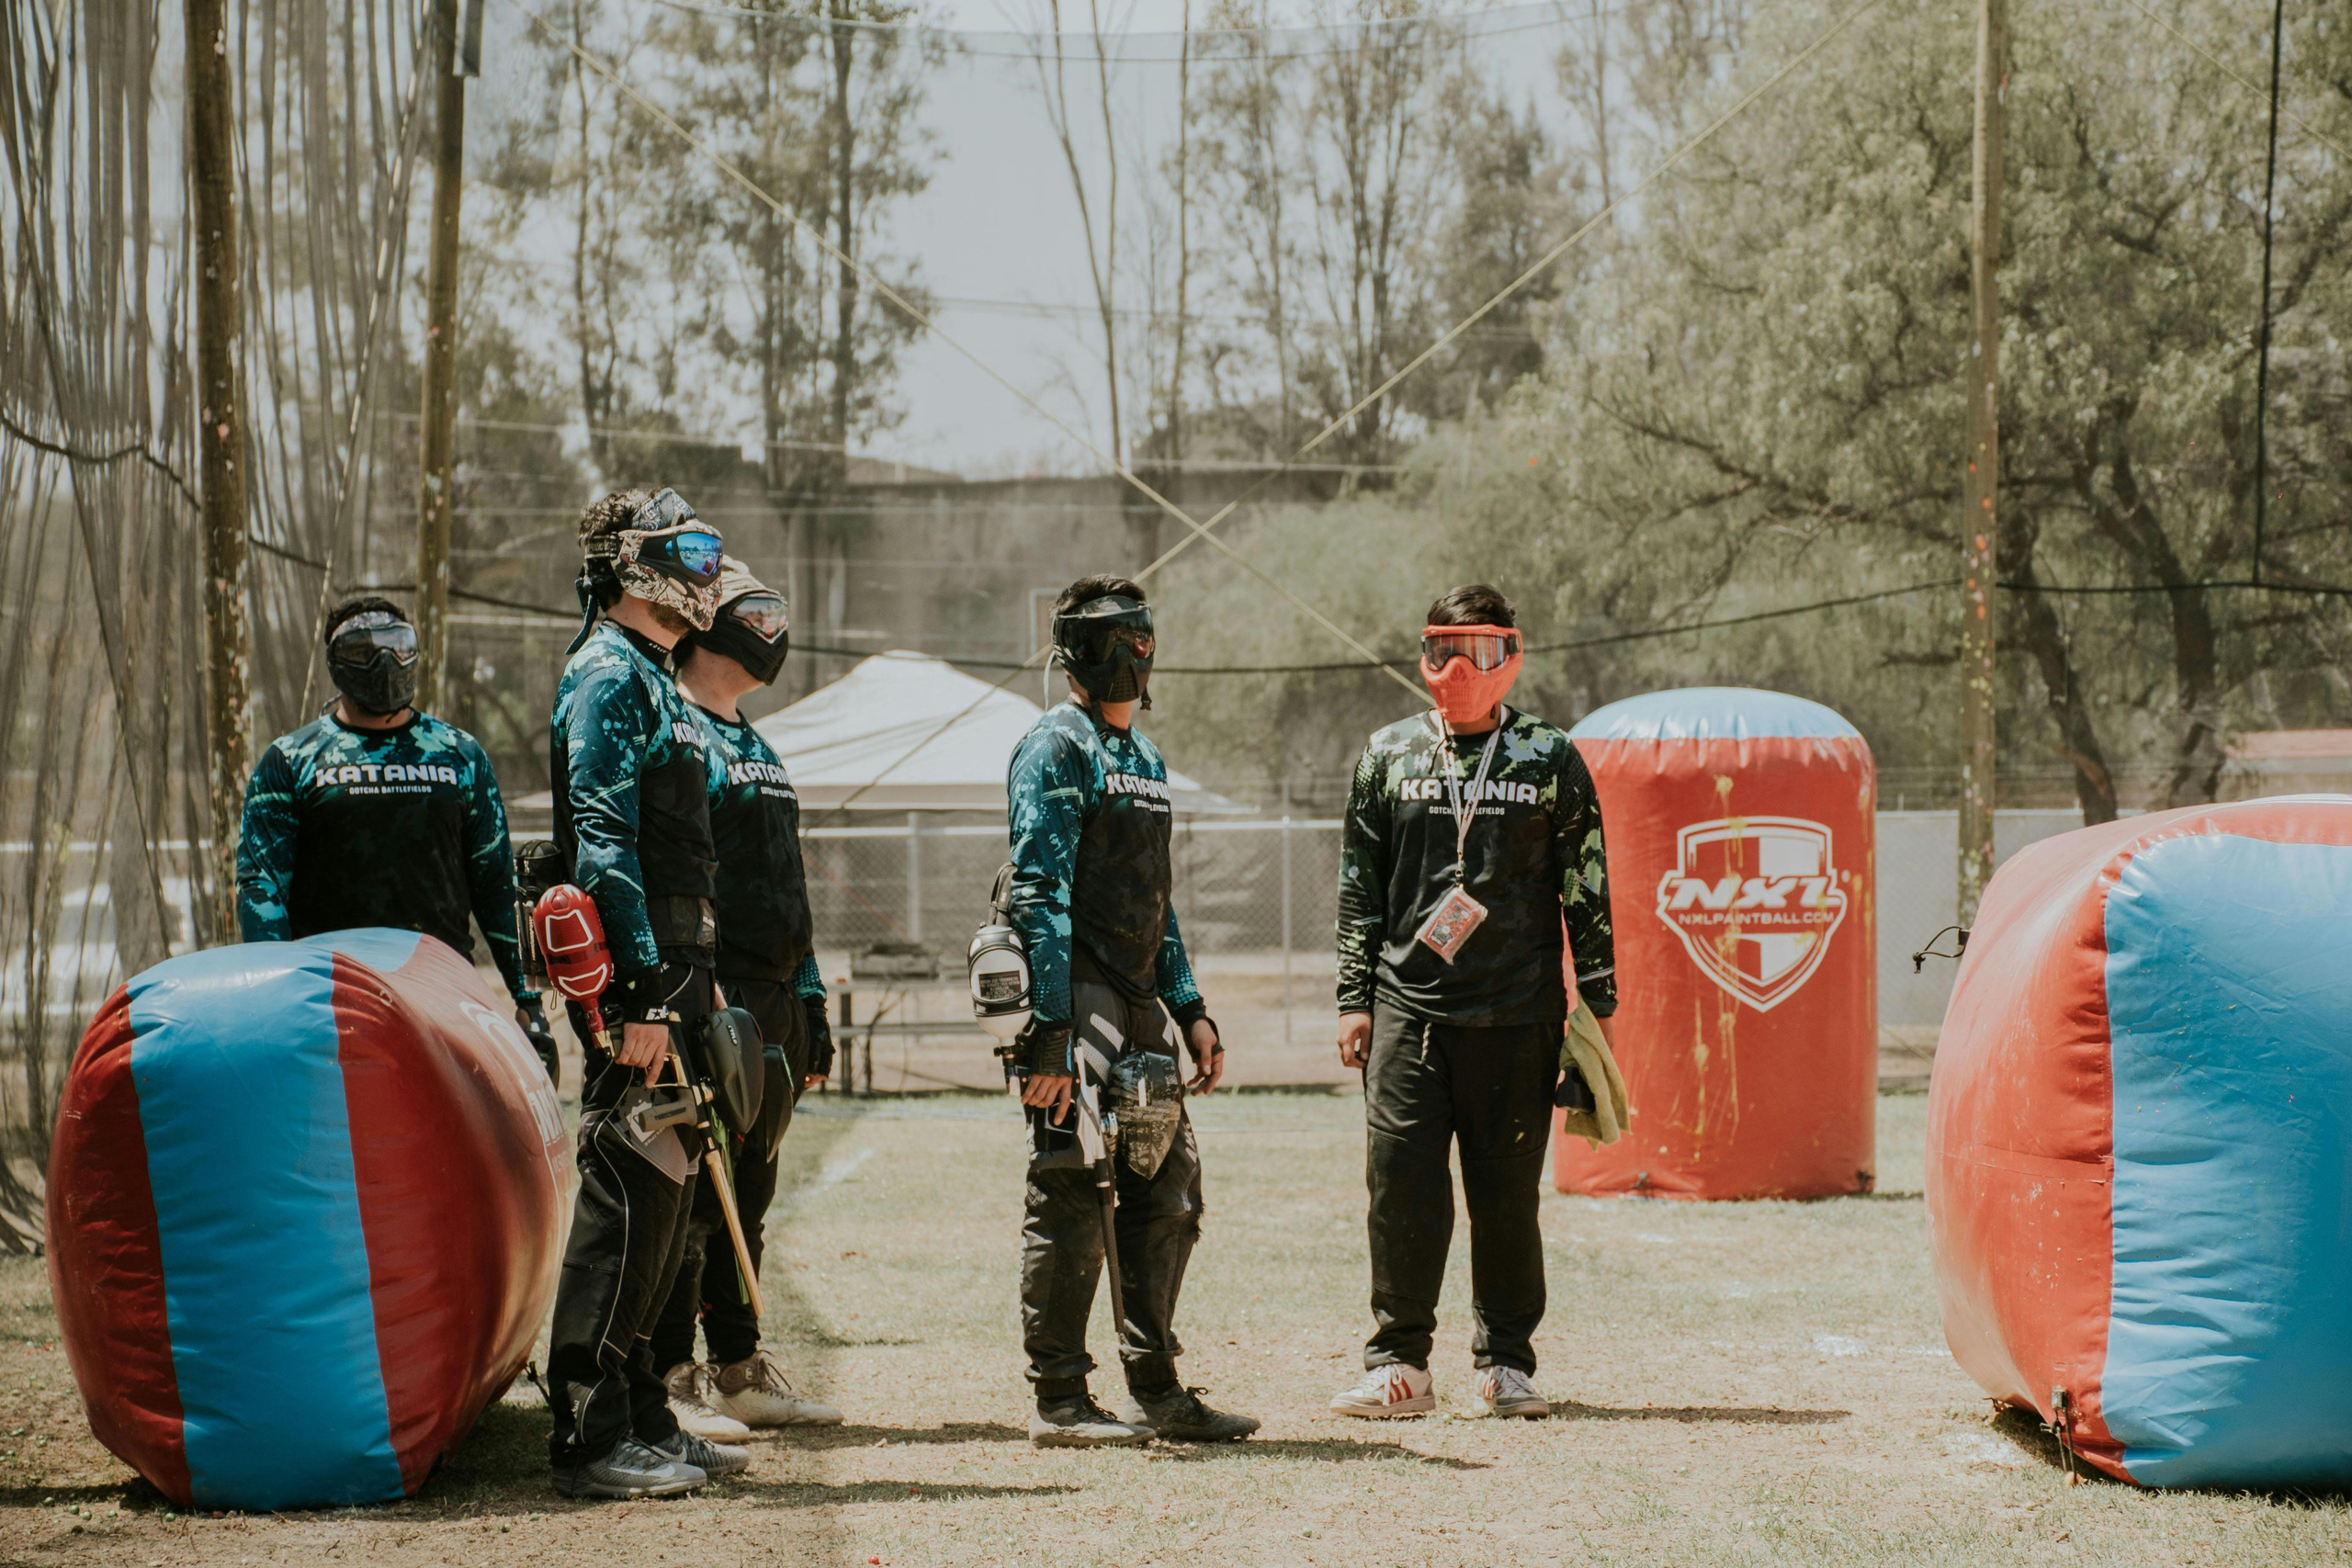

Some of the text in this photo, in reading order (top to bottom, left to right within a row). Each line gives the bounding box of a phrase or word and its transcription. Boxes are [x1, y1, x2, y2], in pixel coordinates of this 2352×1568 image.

[315, 764, 458, 787] KATANIA
[727, 761, 792, 785] KATAN
[349, 784, 432, 795] GOTCHA BATTLEFIELDS
[1104, 773, 1170, 801] KATANI
[1429, 806, 1455, 816] GOTCH
[1668, 876, 1841, 909] NXL
[1679, 912, 1835, 926] NXLPAINTBALL.COM
